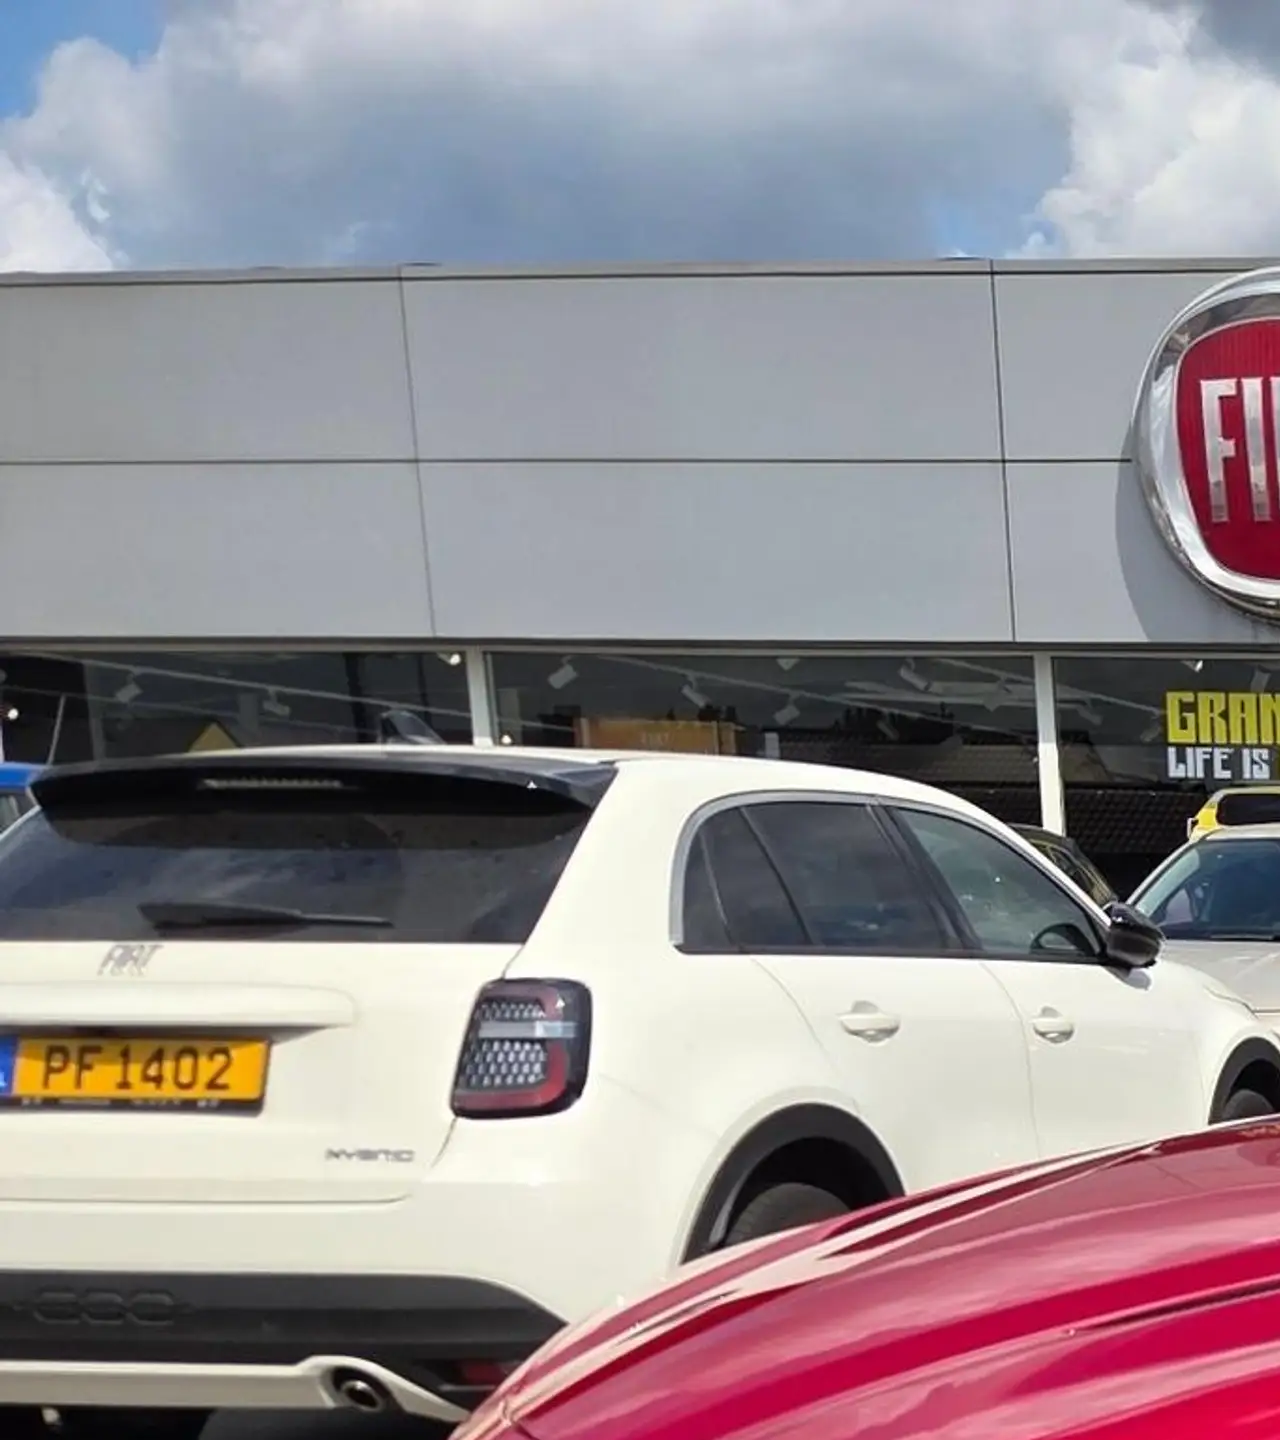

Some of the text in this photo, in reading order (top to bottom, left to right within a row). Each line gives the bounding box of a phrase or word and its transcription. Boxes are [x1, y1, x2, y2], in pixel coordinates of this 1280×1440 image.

[1168, 747, 1233, 780] LIFE
[1243, 749, 1270, 780] IS
[43, 1044, 234, 1091] PF 1402
